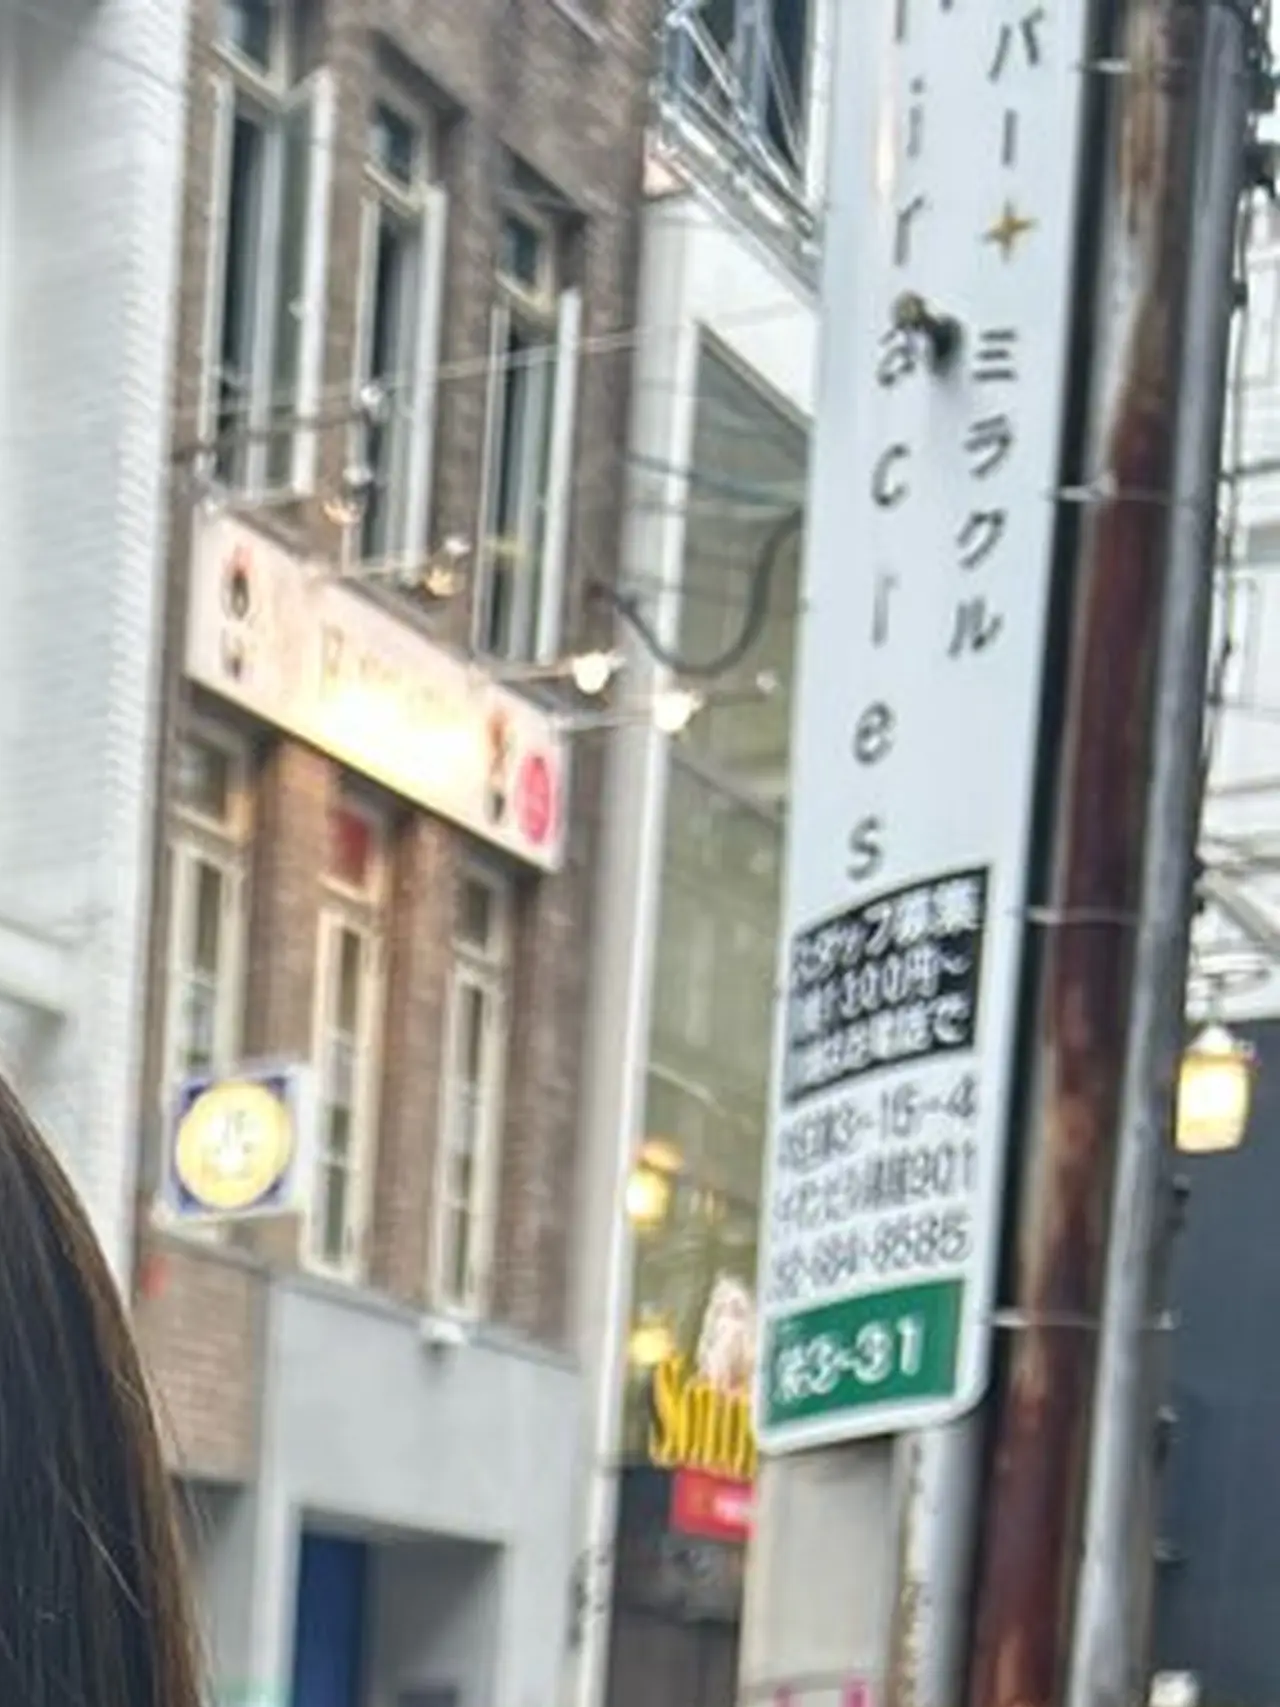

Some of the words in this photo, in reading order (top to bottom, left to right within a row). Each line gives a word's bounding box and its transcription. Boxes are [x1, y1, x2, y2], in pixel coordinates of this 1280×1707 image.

[845, 0, 952, 883] iracles
[946, 328, 1020, 660] ミラクル
